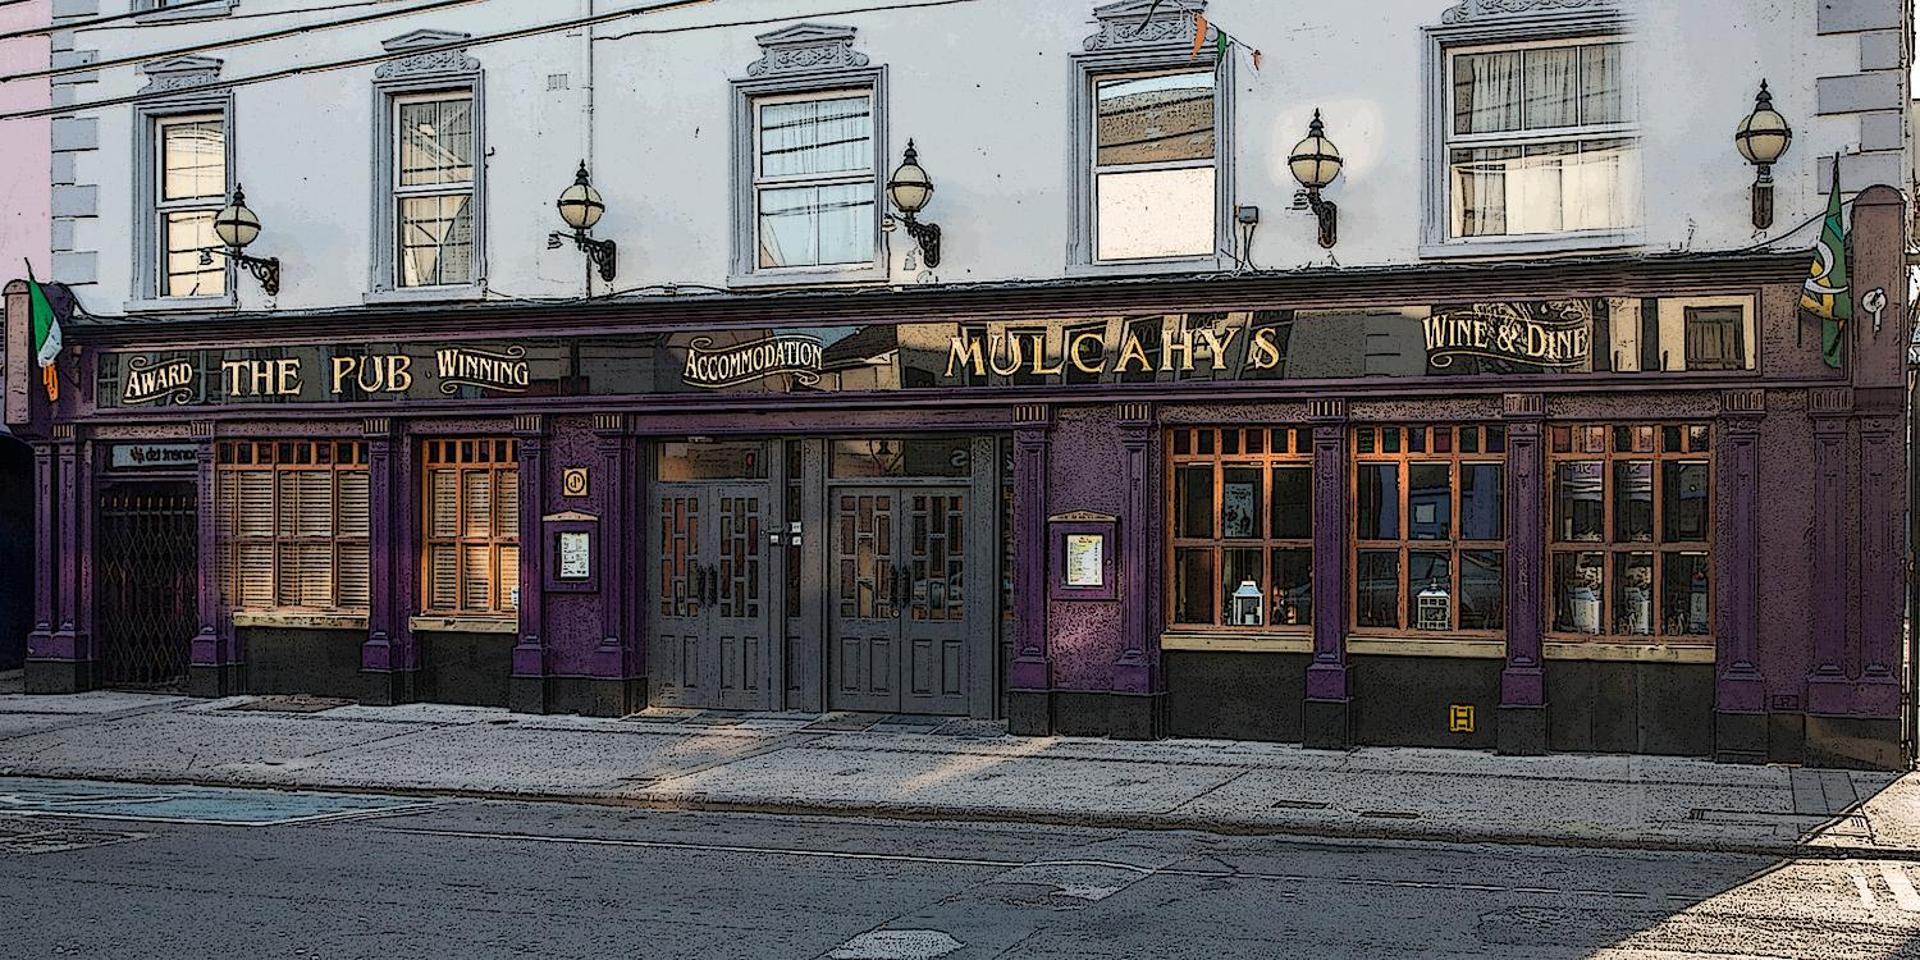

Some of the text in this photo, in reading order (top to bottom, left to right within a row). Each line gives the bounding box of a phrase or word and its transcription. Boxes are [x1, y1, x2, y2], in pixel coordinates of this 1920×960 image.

[944, 326, 1281, 378] MULCAHYS
[1422, 314, 1589, 360] WINE & DINE
[124, 362, 193, 398] AWARD
[222, 354, 413, 397] THE PUB
[436, 349, 530, 386] WINNING
[684, 340, 824, 382] ACCOMMODATION
